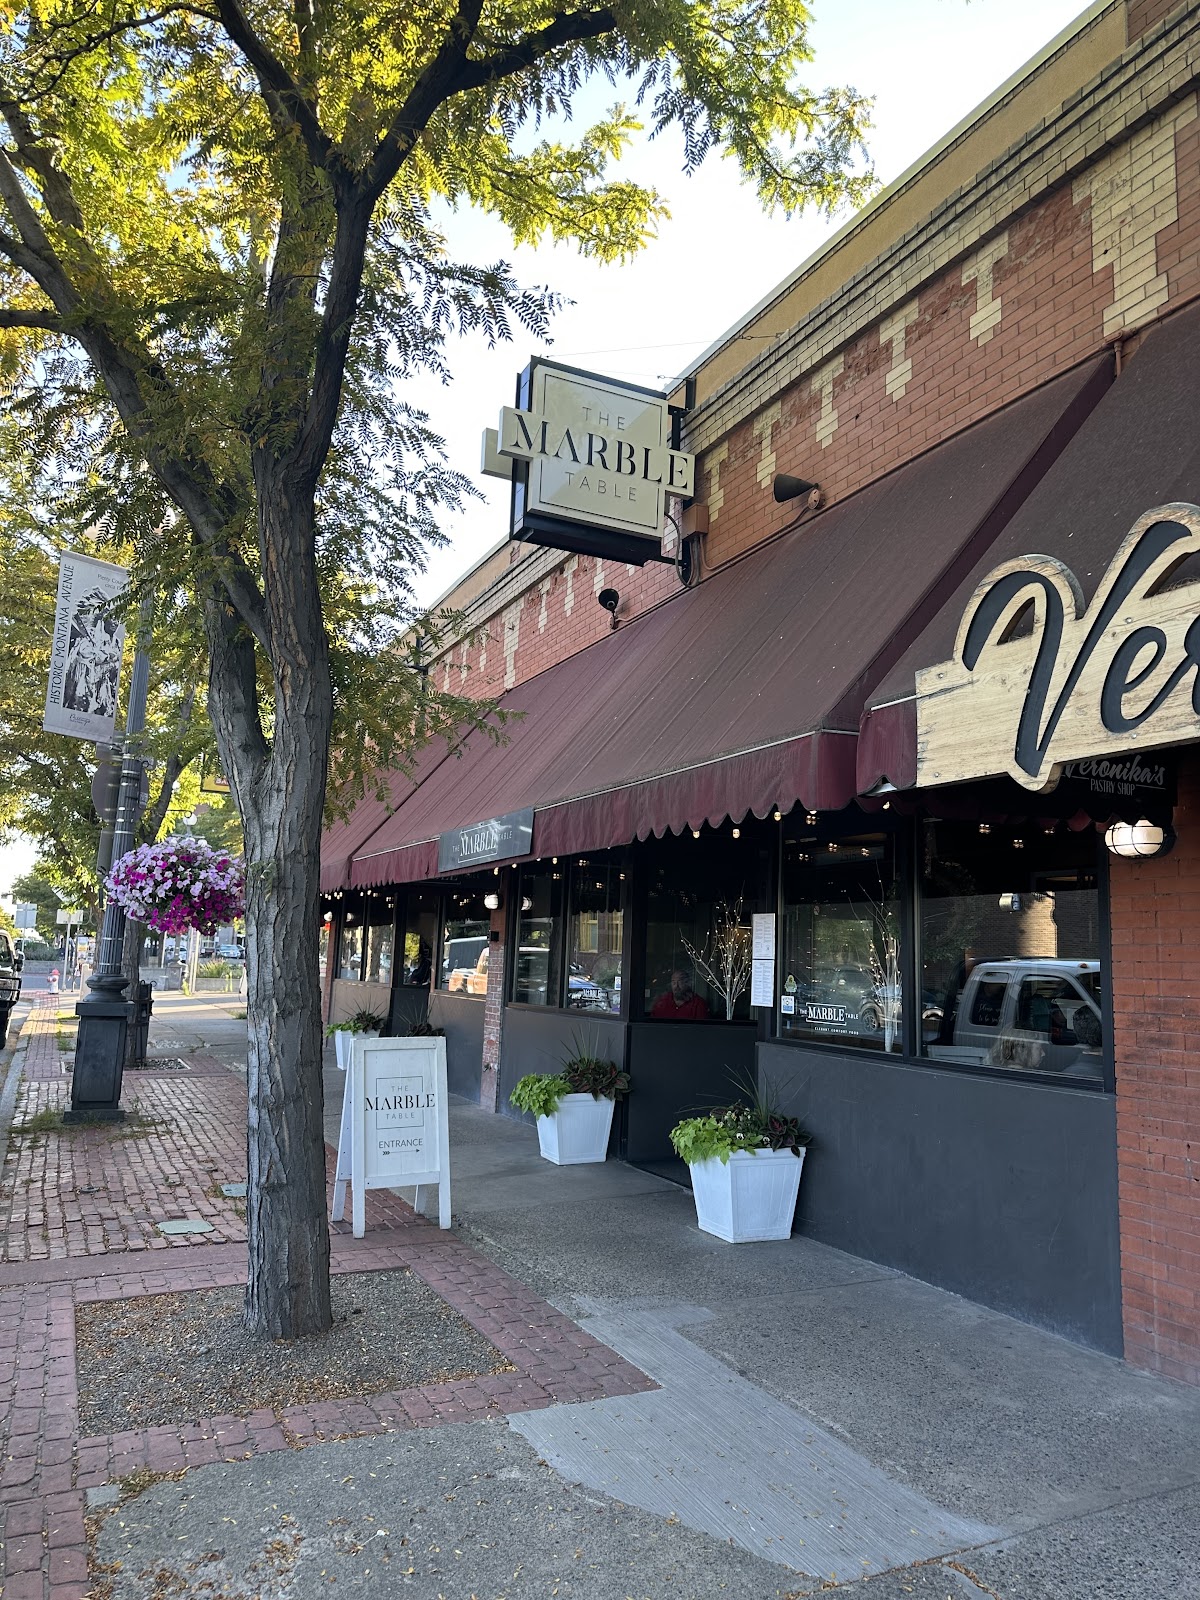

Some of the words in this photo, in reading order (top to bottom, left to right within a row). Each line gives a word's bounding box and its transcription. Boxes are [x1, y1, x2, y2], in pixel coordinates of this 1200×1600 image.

[582, 406, 625, 431] THE
[510, 412, 688, 490] MARBLE
[565, 472, 637, 501] TABLE
[61, 564, 75, 602] AVENUE
[56, 607, 70, 657] MONTANA
[51, 661, 64, 704] HISTORIC
[1090, 778, 1116, 794] PASTRY
[1117, 782, 1136, 796] SHOP
[460, 830, 498, 857] MARBLE
[808, 1006, 845, 1021] MARBLE
[364, 1094, 436, 1111] MARBLE
[386, 1112, 416, 1120] TABLE
[379, 1138, 423, 1149] ENTRANCE
